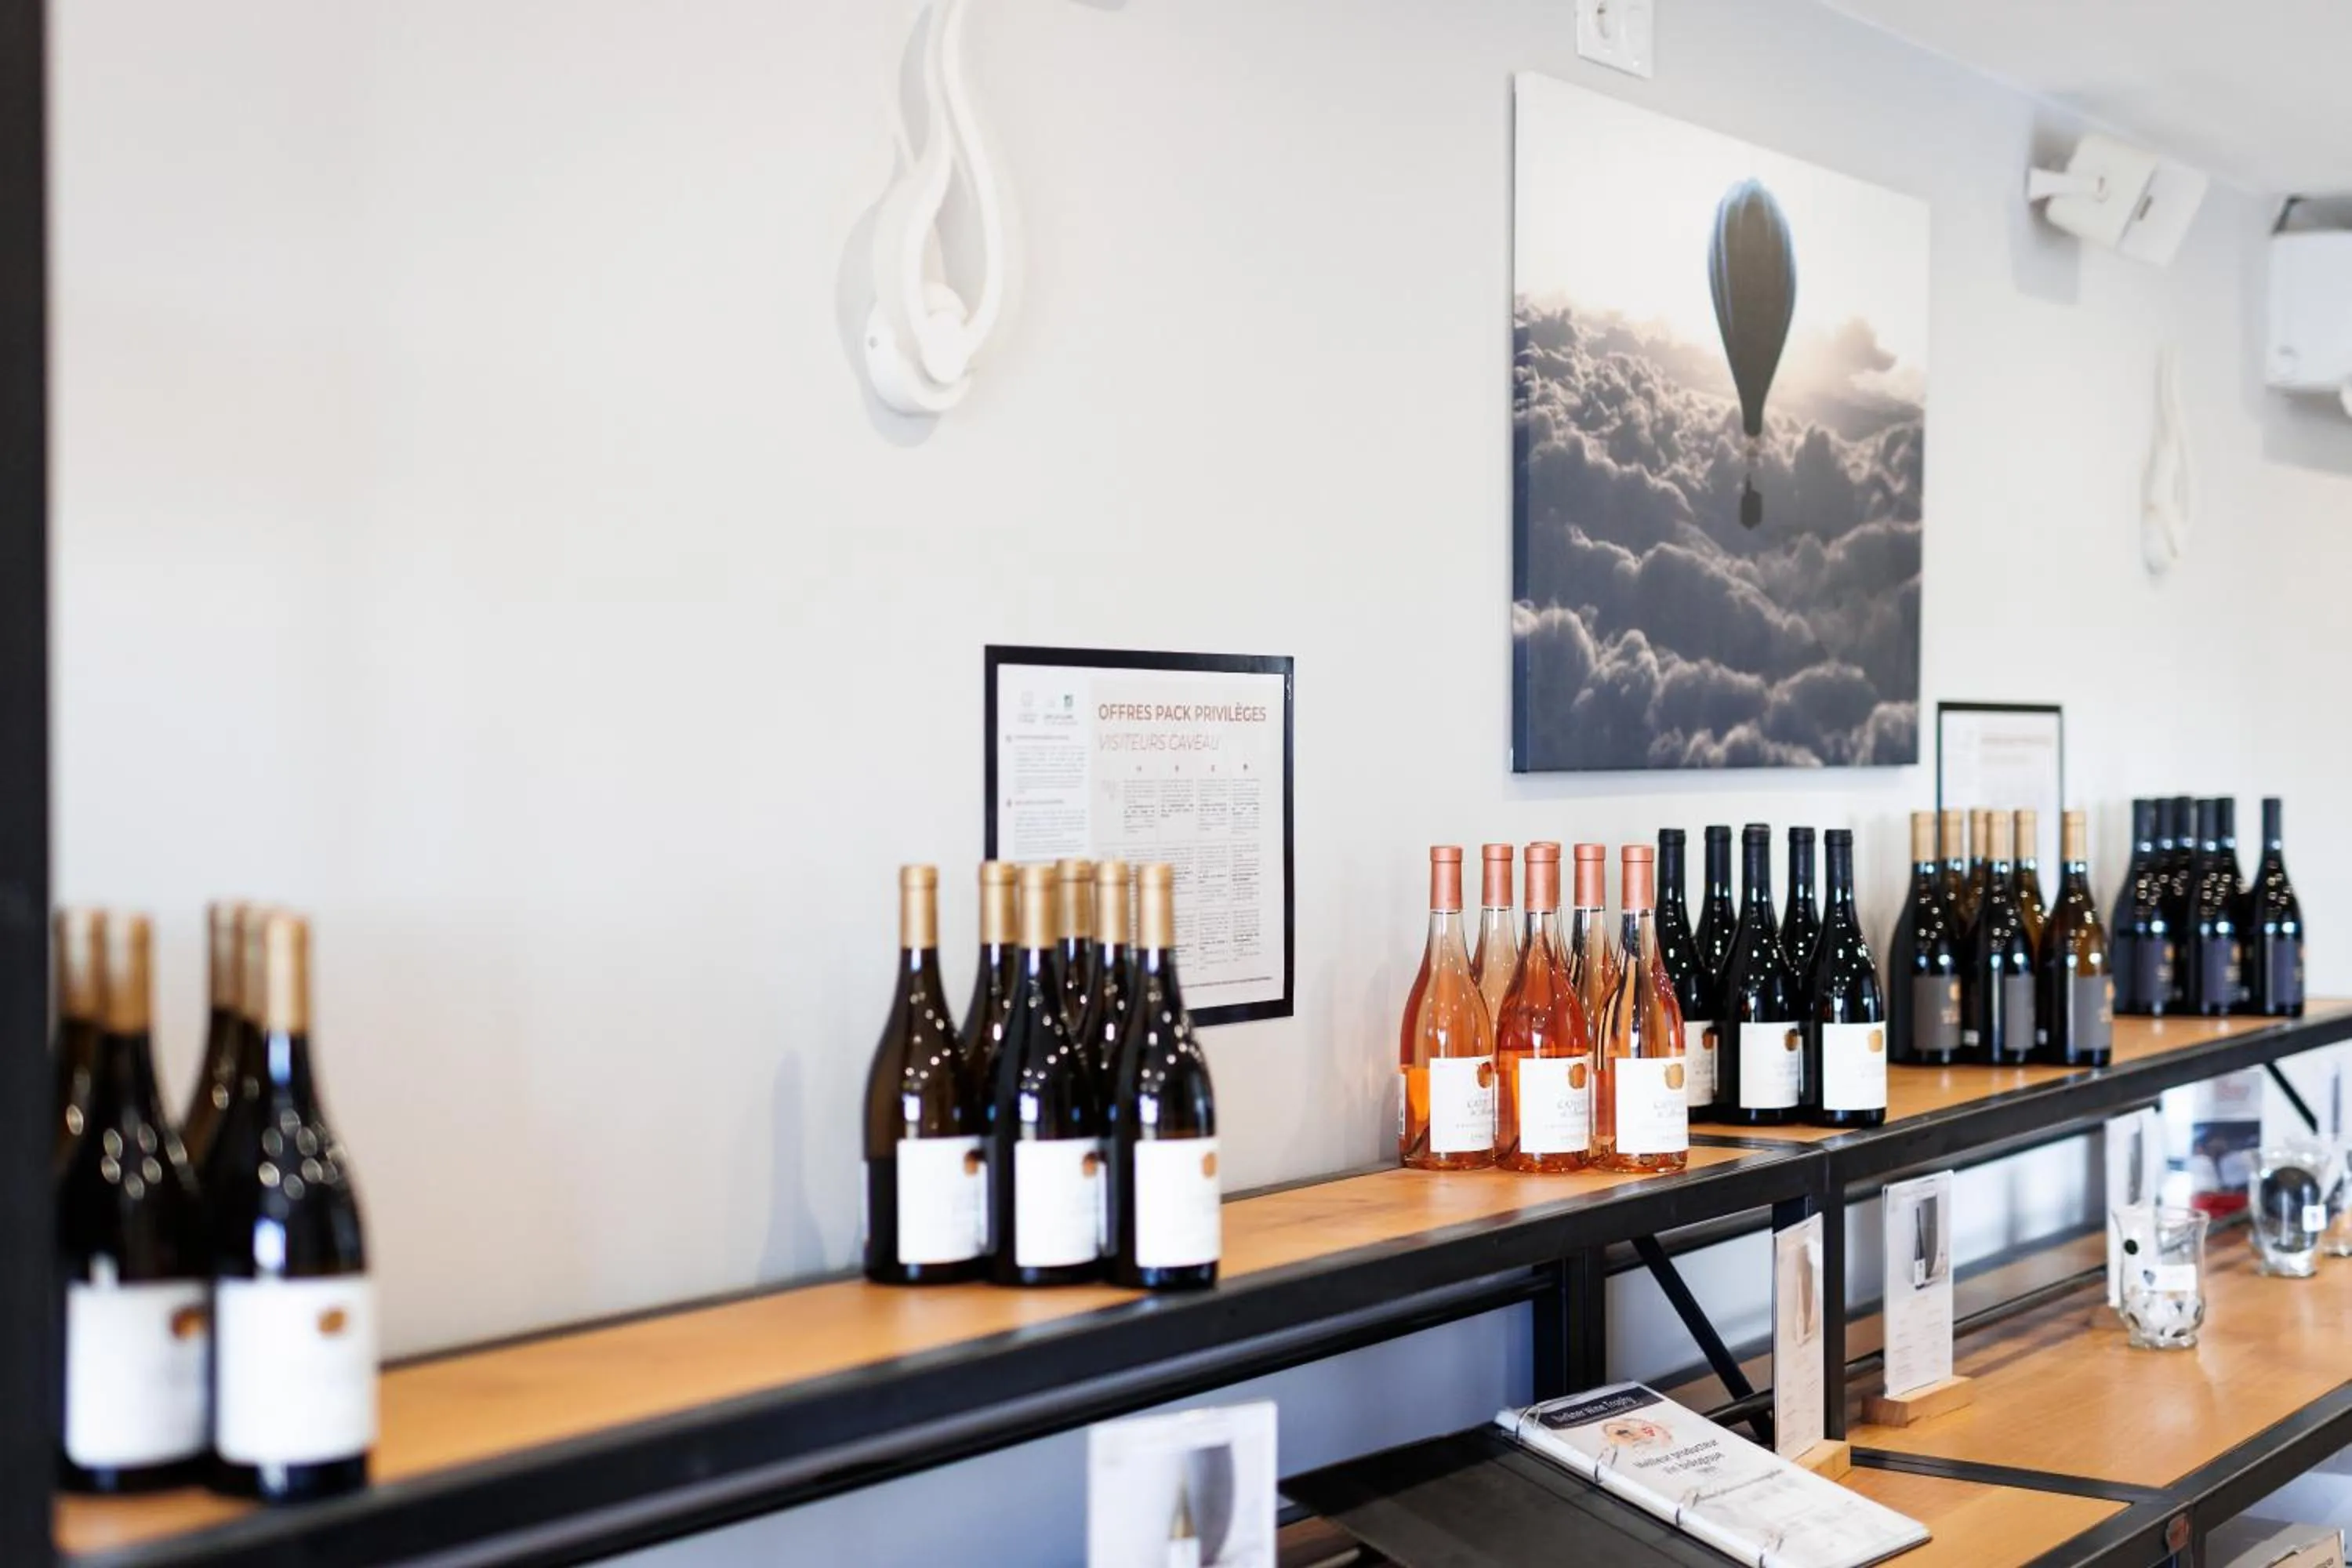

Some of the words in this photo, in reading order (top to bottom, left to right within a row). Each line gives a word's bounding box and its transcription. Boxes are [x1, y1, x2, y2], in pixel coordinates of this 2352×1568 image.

[1098, 704, 1152, 720] OFFRES
[1156, 705, 1192, 721] PACK
[1195, 702, 1267, 722] PRIVILÈGES
[1098, 732, 1167, 750] VISITEURS
[1169, 733, 1221, 750] CAVEAU
